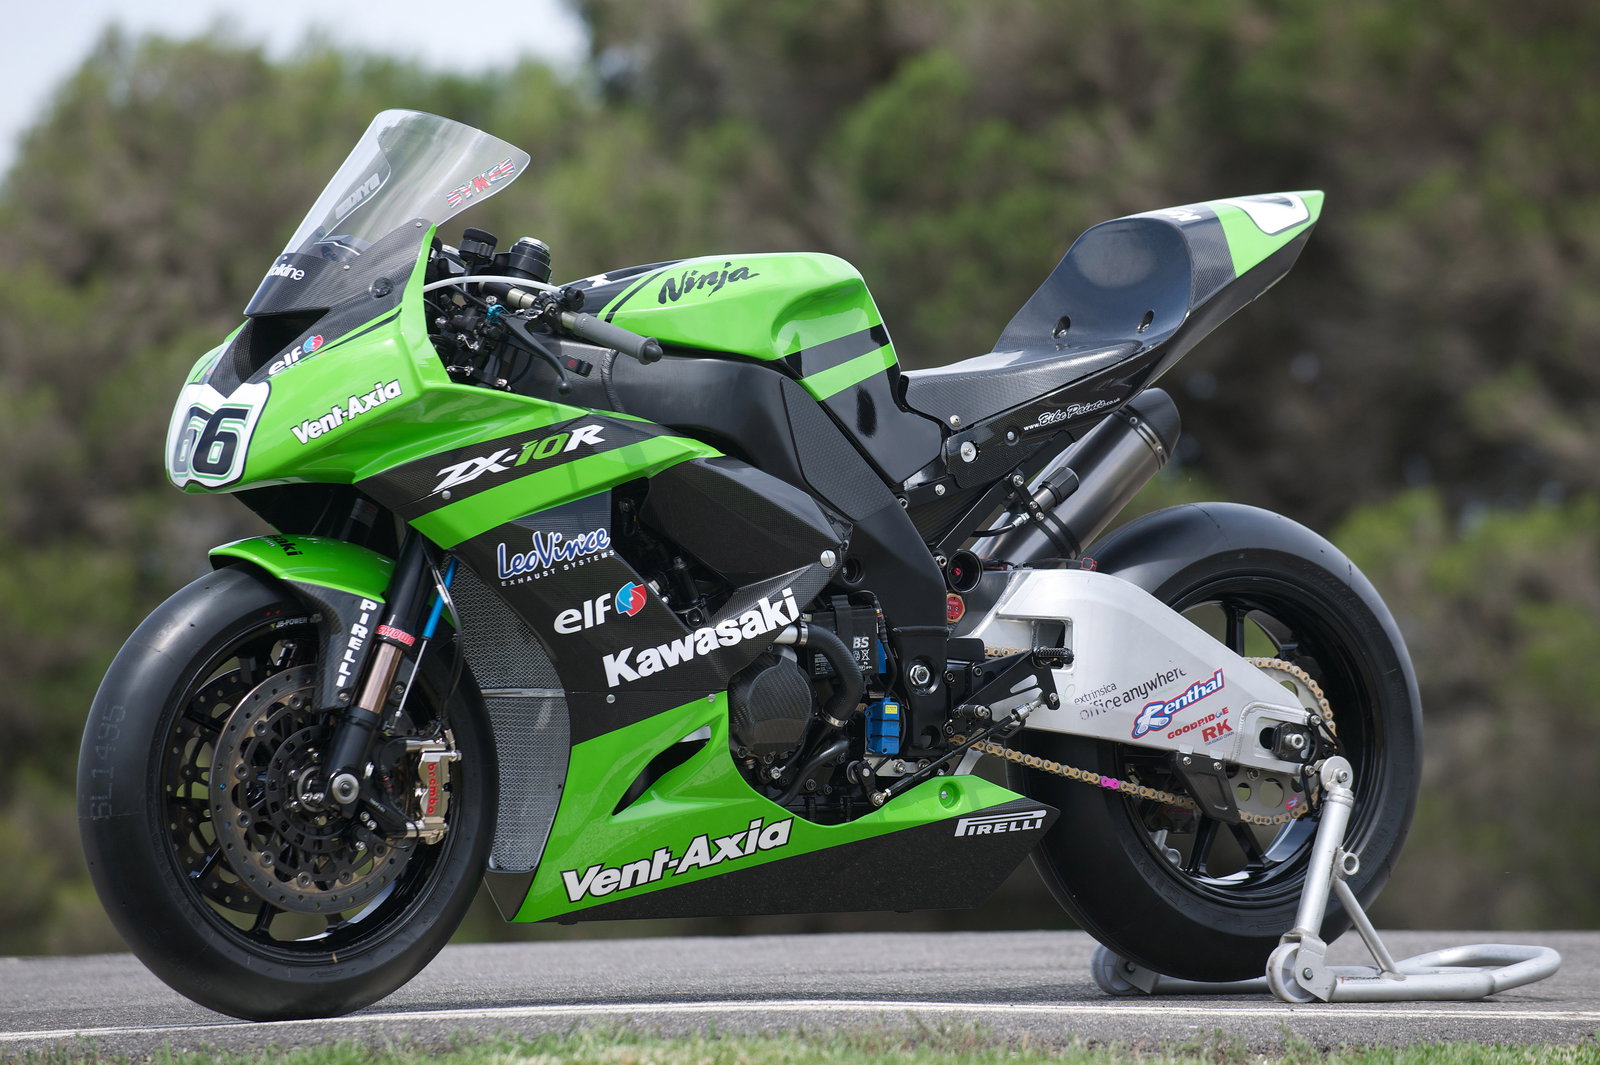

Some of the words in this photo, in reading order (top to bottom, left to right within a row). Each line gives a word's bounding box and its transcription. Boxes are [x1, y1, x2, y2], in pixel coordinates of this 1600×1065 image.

[658, 262, 760, 305] Ninja
[269, 346, 303, 375] elf
[290, 378, 402, 445] Vent-Axia
[173, 402, 254, 481] 66
[432, 424, 606, 492] ZX-10R
[497, 528, 611, 580] LeoVince
[501, 568, 556, 587] EXHAUST
[563, 550, 615, 571] SYSTEMS
[554, 593, 613, 634] elf
[336, 599, 377, 687] PIRELLI
[375, 624, 416, 647] SHOWA
[602, 587, 800, 688] Kawasaki
[853, 636, 869, 649] BS
[1074, 683, 1117, 705] extrinsica
[1131, 668, 1224, 739] Renthal
[1167, 707, 1229, 740] GOODRIDGE
[1201, 718, 1233, 742] RK
[427, 762, 439, 815] brembo
[954, 809, 1047, 837] PIRELLI
[560, 816, 795, 904] Vent-Axia
